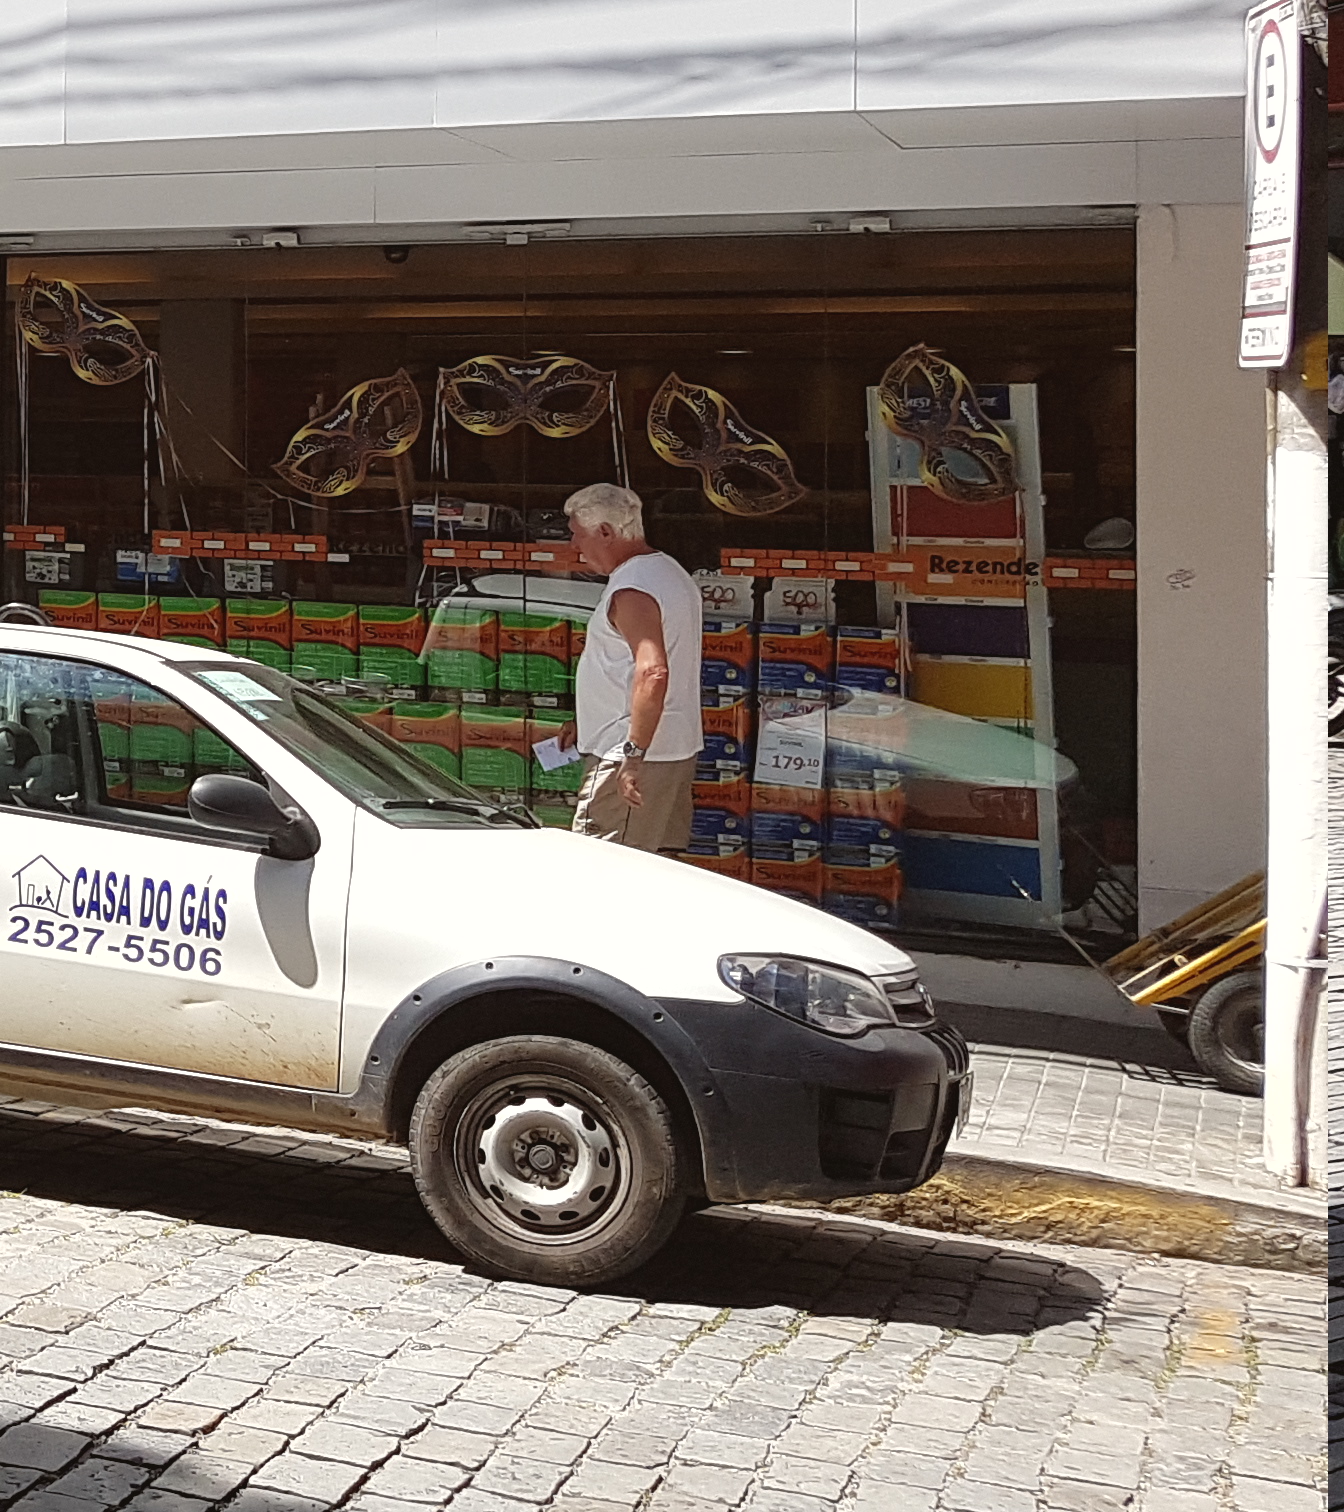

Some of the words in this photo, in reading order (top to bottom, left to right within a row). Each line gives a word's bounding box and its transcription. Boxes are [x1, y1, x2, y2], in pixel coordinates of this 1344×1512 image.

[929, 554, 1039, 576] Rezende
[233, 620, 286, 634] Suvinil
[365, 626, 419, 640] Suvinil
[72, 867, 131, 925] CASA
[139, 877, 172, 931] DO
[180, 875, 227, 941] GÁS
[7, 915, 222, 976] 2527-5506
